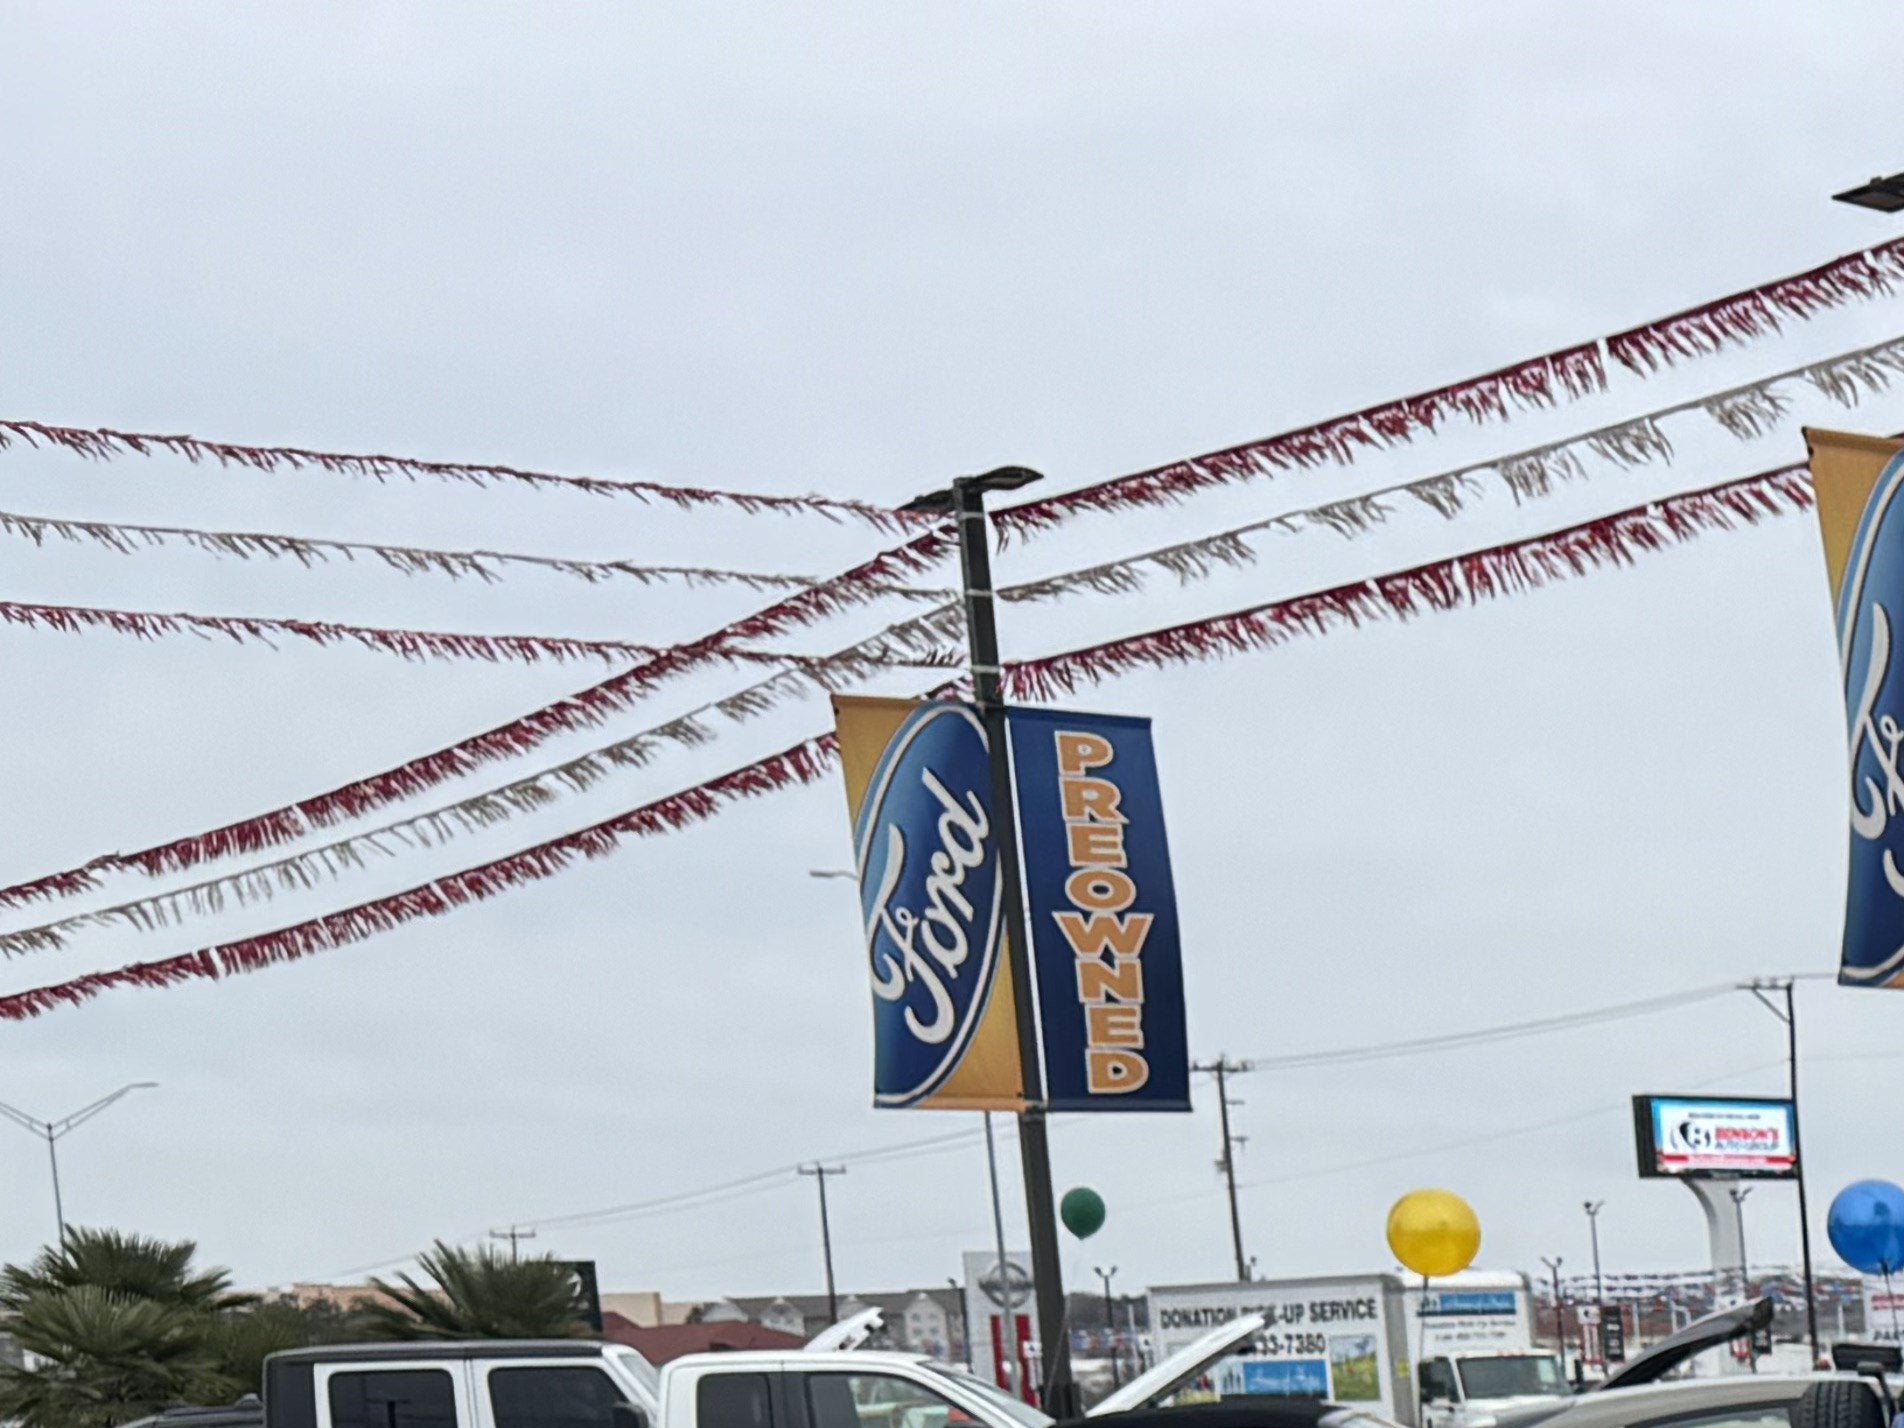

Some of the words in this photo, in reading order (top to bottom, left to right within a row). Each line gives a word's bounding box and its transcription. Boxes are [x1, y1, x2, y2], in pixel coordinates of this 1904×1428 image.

[866, 766, 990, 1044] Ford
[1052, 730, 1154, 1094] PREOWNED
[1309, 1297, 1378, 1323] SERVICE
